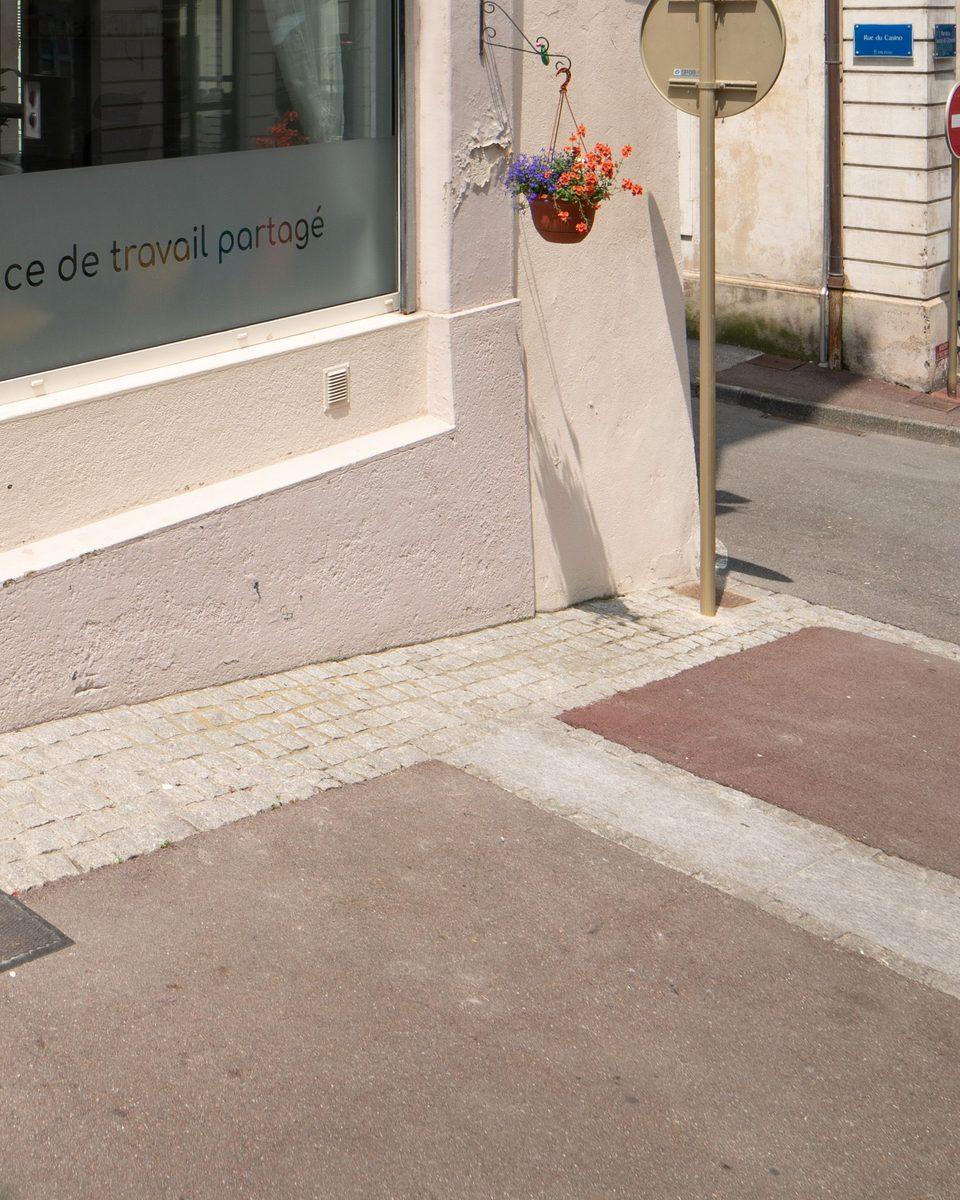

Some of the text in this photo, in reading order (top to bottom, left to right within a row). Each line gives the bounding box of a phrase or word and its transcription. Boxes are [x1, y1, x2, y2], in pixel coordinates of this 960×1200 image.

[57, 243, 100, 282] de
[110, 224, 209, 272] travail
[218, 205, 325, 263] partagé
